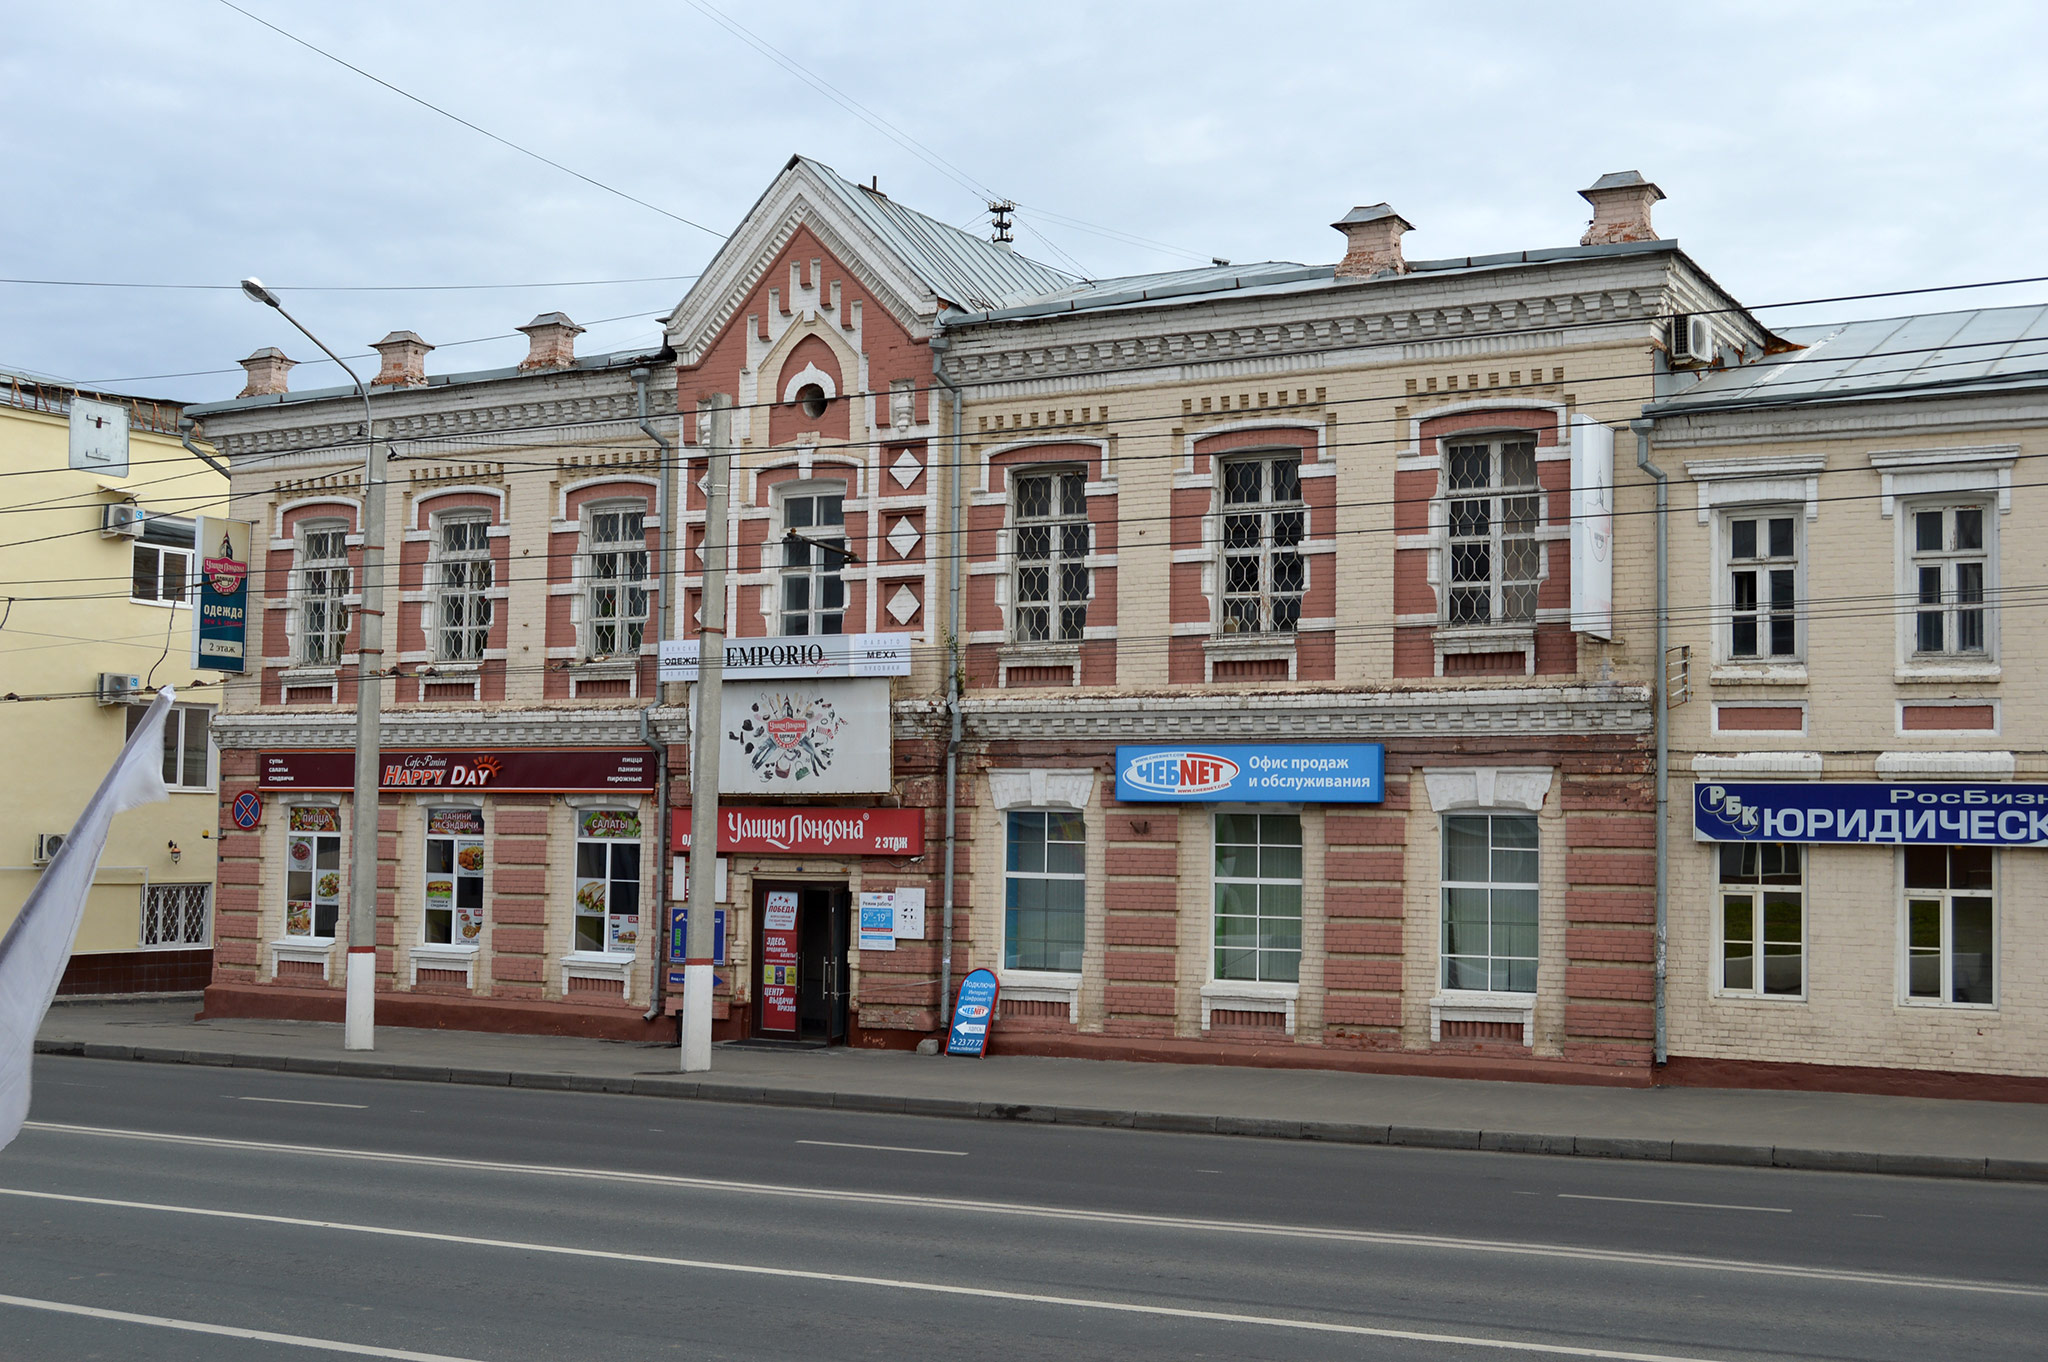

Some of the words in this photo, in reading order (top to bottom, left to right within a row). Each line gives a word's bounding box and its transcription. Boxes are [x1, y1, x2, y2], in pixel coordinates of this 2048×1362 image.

[204, 604, 243, 618] одежда
[209, 642, 214, 651] 2
[215, 644, 236, 653] этаж
[725, 643, 823, 667] EMPORIO
[866, 651, 897, 659] МЕХА
[664, 656, 699, 666] ОДЕЖД
[1248, 755, 1288, 772] Офис
[1291, 758, 1349, 772] продаж
[1136, 759, 1223, 787] ЧЕБNET
[1248, 777, 1258, 788] и
[1261, 773, 1370, 791] обслуживания
[1709, 785, 1759, 827] РБК
[302, 814, 330, 825] ПИЦЦА
[441, 812, 472, 821] ПАНИНИ
[435, 821, 440, 829] И
[441, 821, 479, 830] СЭНДВИЧИ
[591, 819, 628, 829] САЛАТЫ
[1763, 807, 2048, 843] ЮРИДИЧЕСК
[728, 812, 790, 850] Улицы
[787, 814, 863, 846] Лондона
[875, 836, 881, 849] 2
[882, 836, 908, 852] ЭТАЖ
[768, 905, 795, 914] ПОБЕДА
[766, 936, 786, 947] ЗДЕСЬ
[764, 987, 785, 997] ЦЕНТР
[768, 996, 794, 1005] ВЫДАЧИ
[777, 1004, 797, 1013] ПРИЗОВ
[957, 1038, 966, 1046] 23
[966, 1039, 975, 1047] 77
[975, 1039, 984, 1047] 77
